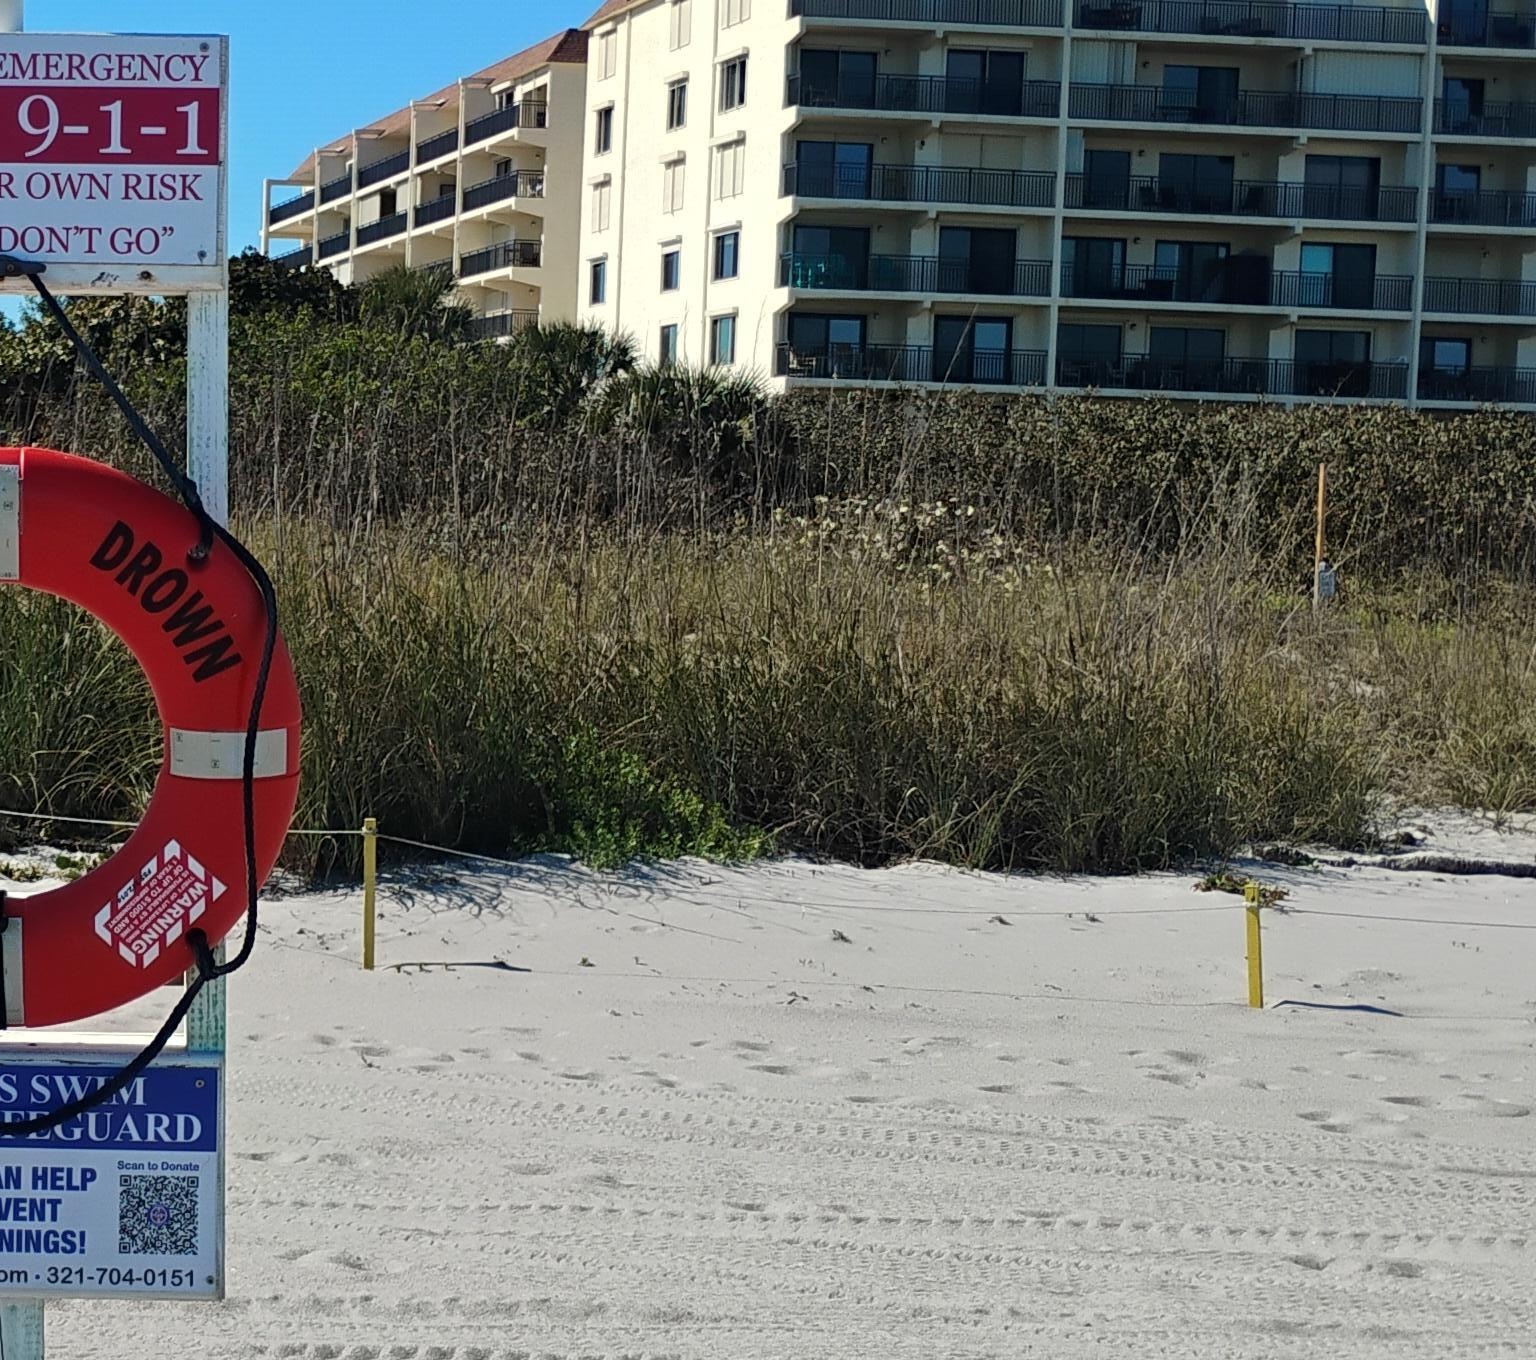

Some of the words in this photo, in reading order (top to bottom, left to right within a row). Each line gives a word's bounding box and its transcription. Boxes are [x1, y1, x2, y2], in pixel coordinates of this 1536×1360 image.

[18, 94, 209, 157] 9-1-1
[26, 173, 113, 200] OWN
[121, 174, 203, 201] RISK
[110, 226, 175, 255] GO”
[90, 520, 242, 683] DROWN
[160, 874, 173, 887] UP
[173, 864, 184, 875] OF
[150, 885, 162, 898] TO
[112, 916, 131, 934] AND
[131, 881, 208, 954] WARNING
[117, 1160, 144, 1170] Scan
[148, 1161, 158, 1171] to
[161, 1161, 200, 1171] Donate
[31, 1167, 97, 1192] HELP
[47, 1267, 195, 1287] 321-704-0151
